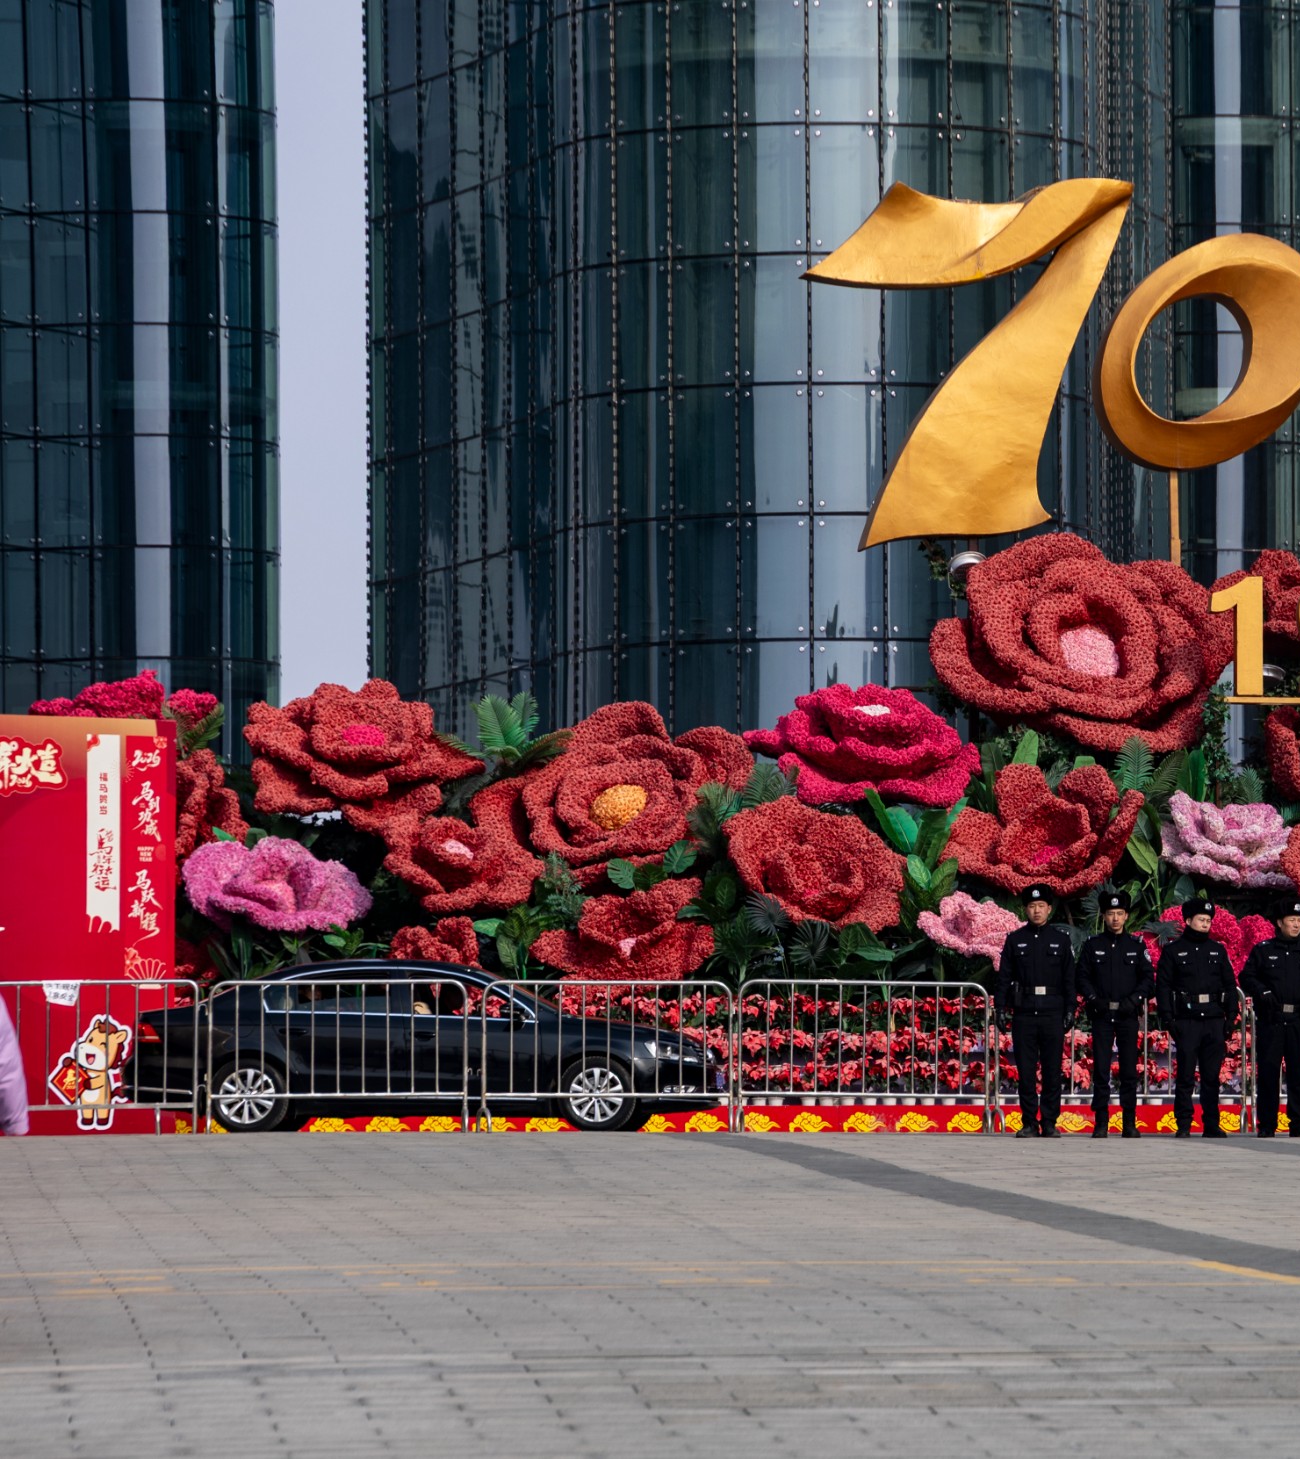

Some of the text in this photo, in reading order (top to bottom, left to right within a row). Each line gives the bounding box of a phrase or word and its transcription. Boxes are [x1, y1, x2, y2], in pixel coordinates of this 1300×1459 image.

[132, 750, 161, 771] 2026
[132, 781, 162, 842] 马到功成
